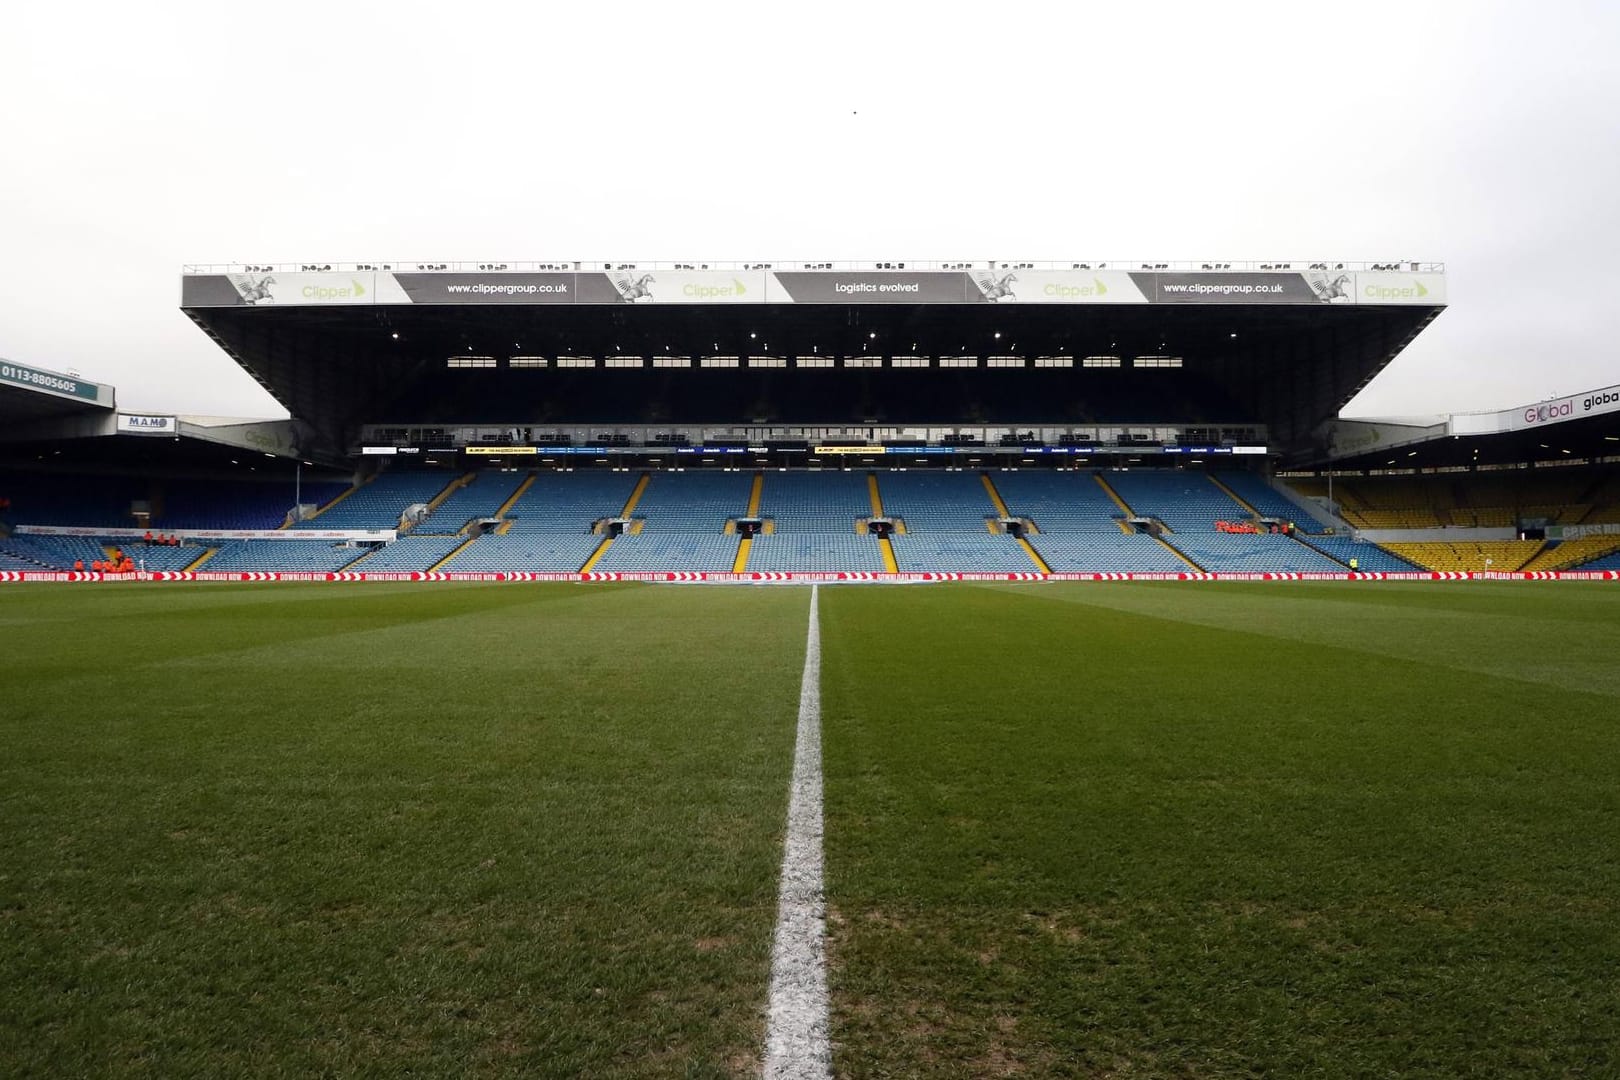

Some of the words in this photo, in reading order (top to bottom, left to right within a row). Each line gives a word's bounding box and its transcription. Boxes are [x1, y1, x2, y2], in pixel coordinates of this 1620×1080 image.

[302, 286, 352, 299] Clipper
[447, 283, 567, 295] www.clippergroup.co.uk
[683, 283, 733, 298] Clipper
[835, 283, 877, 294] Logistics
[879, 283, 919, 293] evolved
[1044, 283, 1094, 298] Clipper
[1164, 283, 1284, 295] www.clippergroup.co.uk
[1364, 285, 1415, 299] Clipper
[2, 366, 76, 392] 0113-8805605
